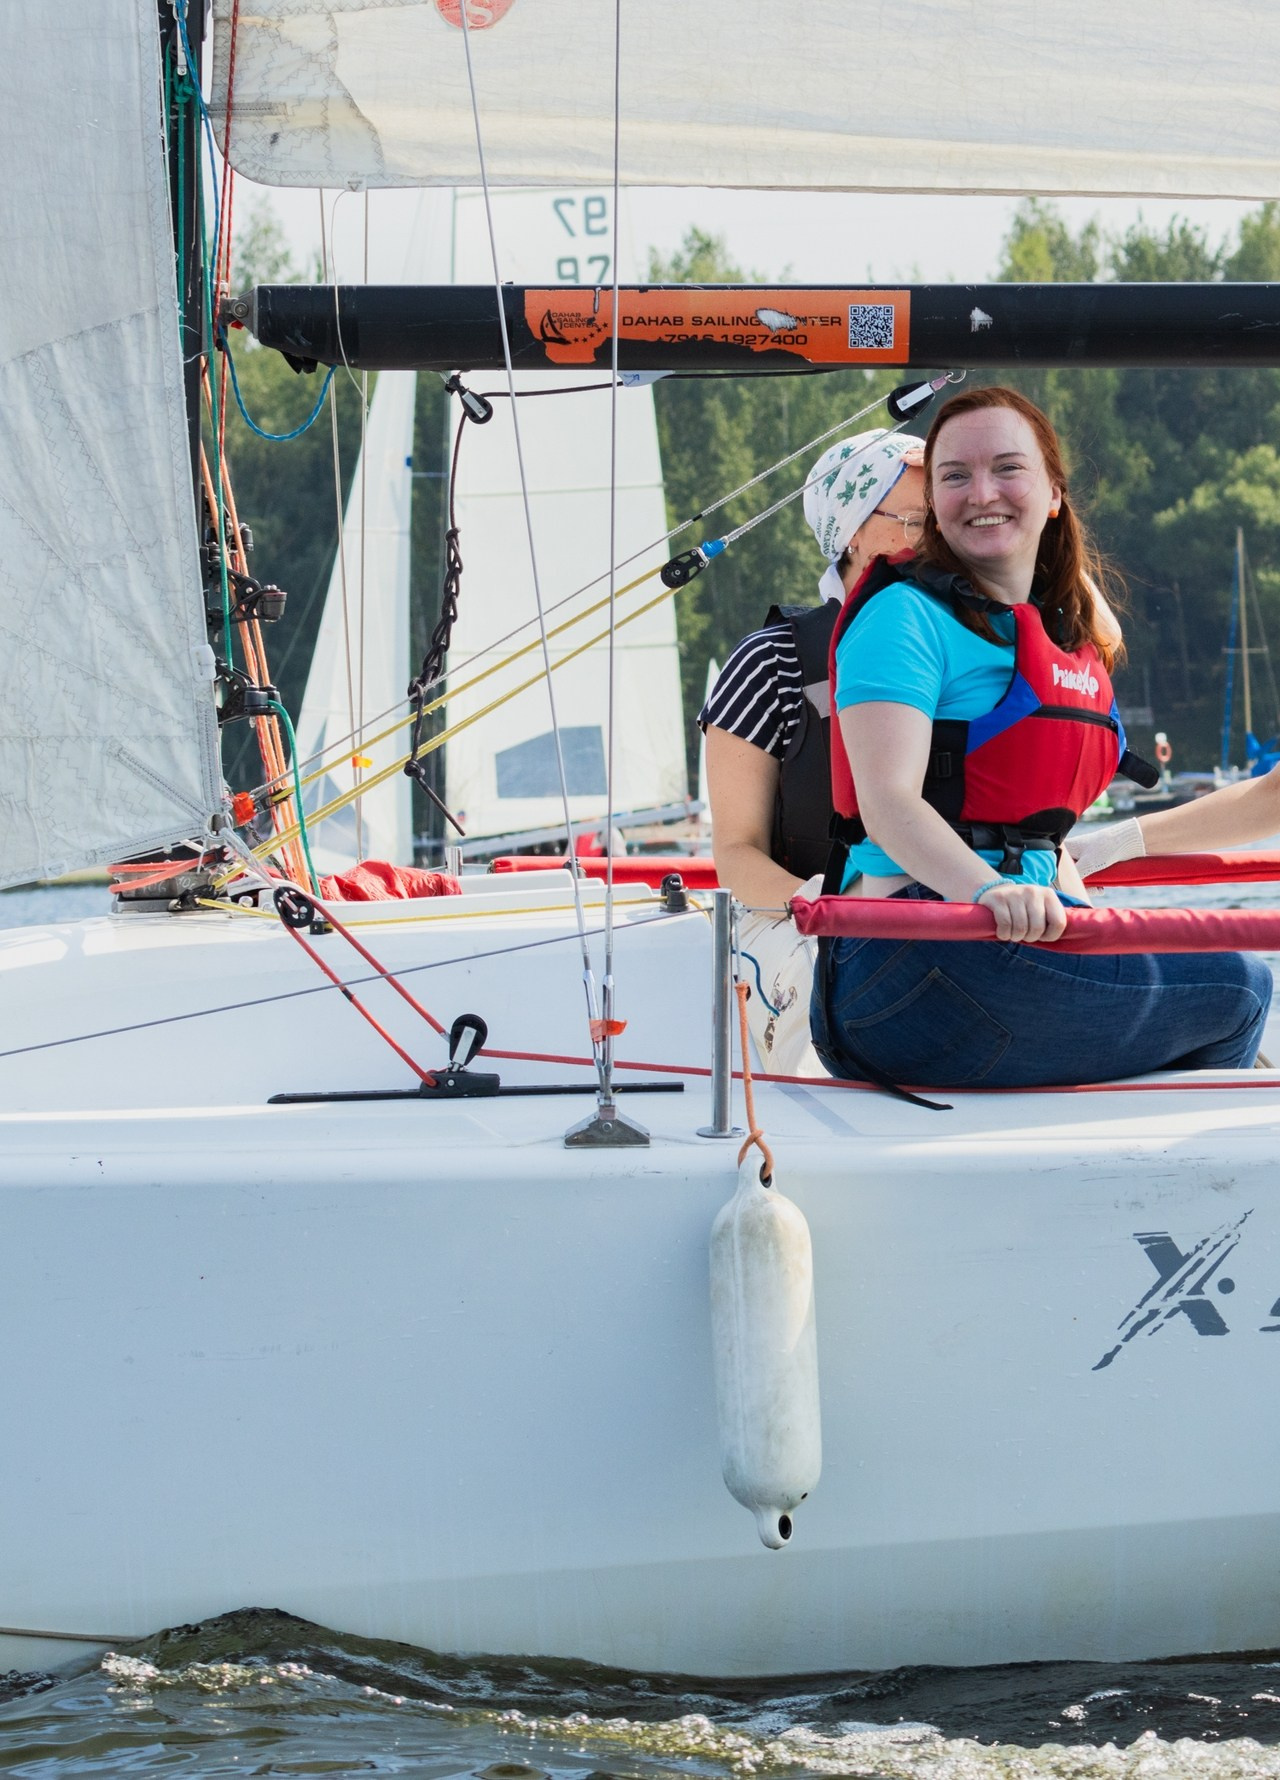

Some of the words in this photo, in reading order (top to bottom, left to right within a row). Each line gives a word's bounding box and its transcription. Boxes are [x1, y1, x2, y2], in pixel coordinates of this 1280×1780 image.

[622, 315, 685, 327] DAHAB
[690, 315, 762, 327] SAILING
[720, 334, 808, 346] 1927400
